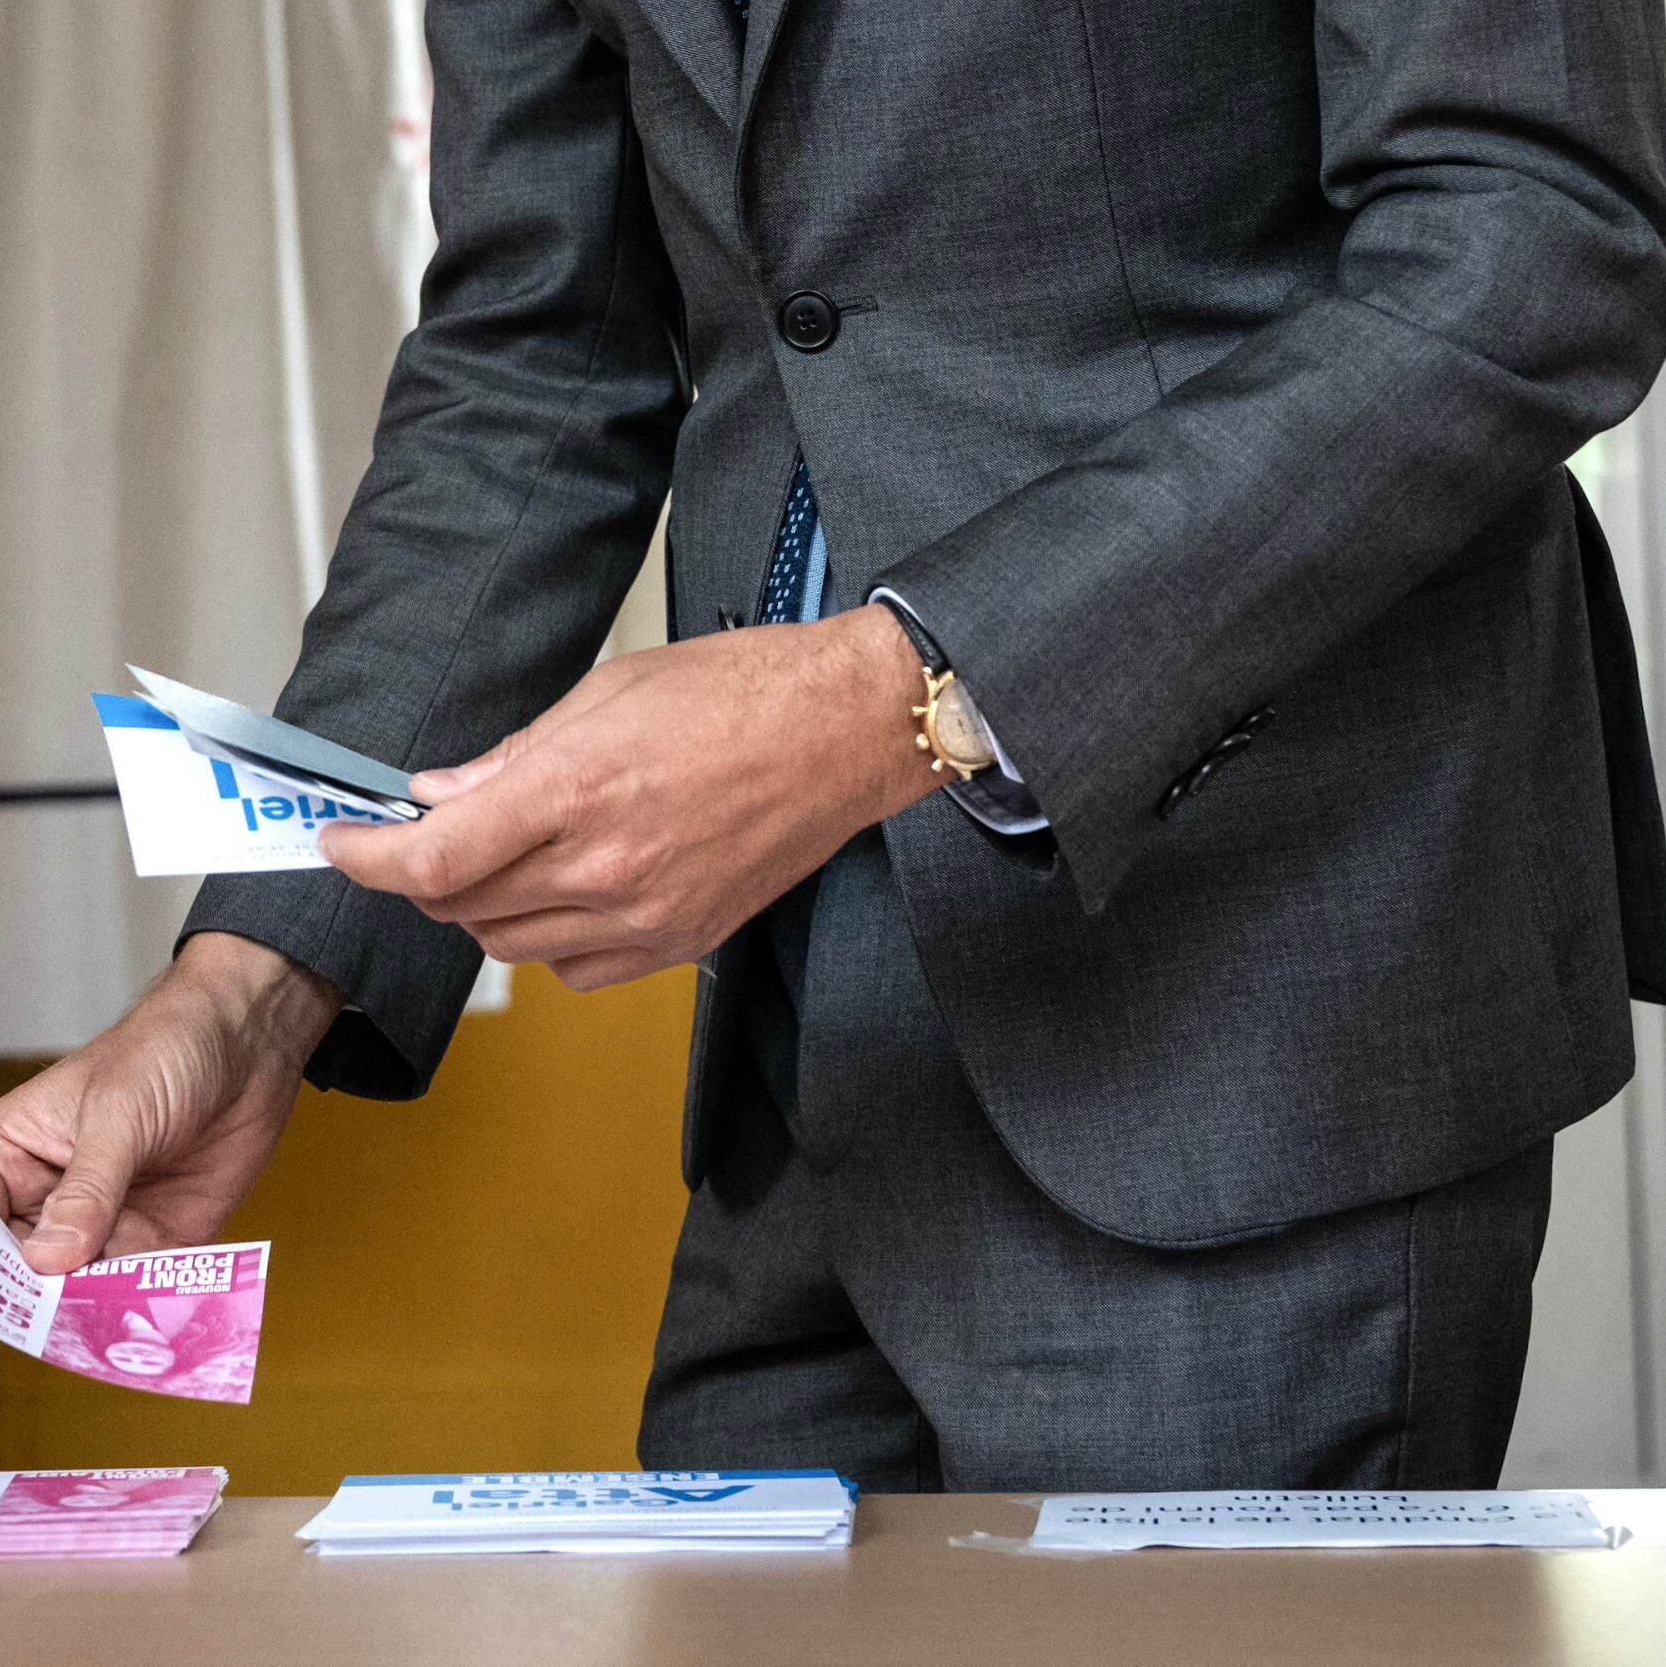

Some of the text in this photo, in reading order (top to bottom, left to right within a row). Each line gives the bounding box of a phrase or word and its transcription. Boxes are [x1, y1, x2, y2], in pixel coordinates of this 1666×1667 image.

[136, 1268, 232, 1289] FRONT
[175, 1284, 230, 1294] NOUVEAU
[460, 1473, 720, 1484] ENSEMBLE
[431, 1485, 755, 1504] Attal
[451, 1500, 679, 1511] Gabriel
[1064, 1517, 1160, 1525] liste
[1310, 1516, 1516, 1524] candidat
